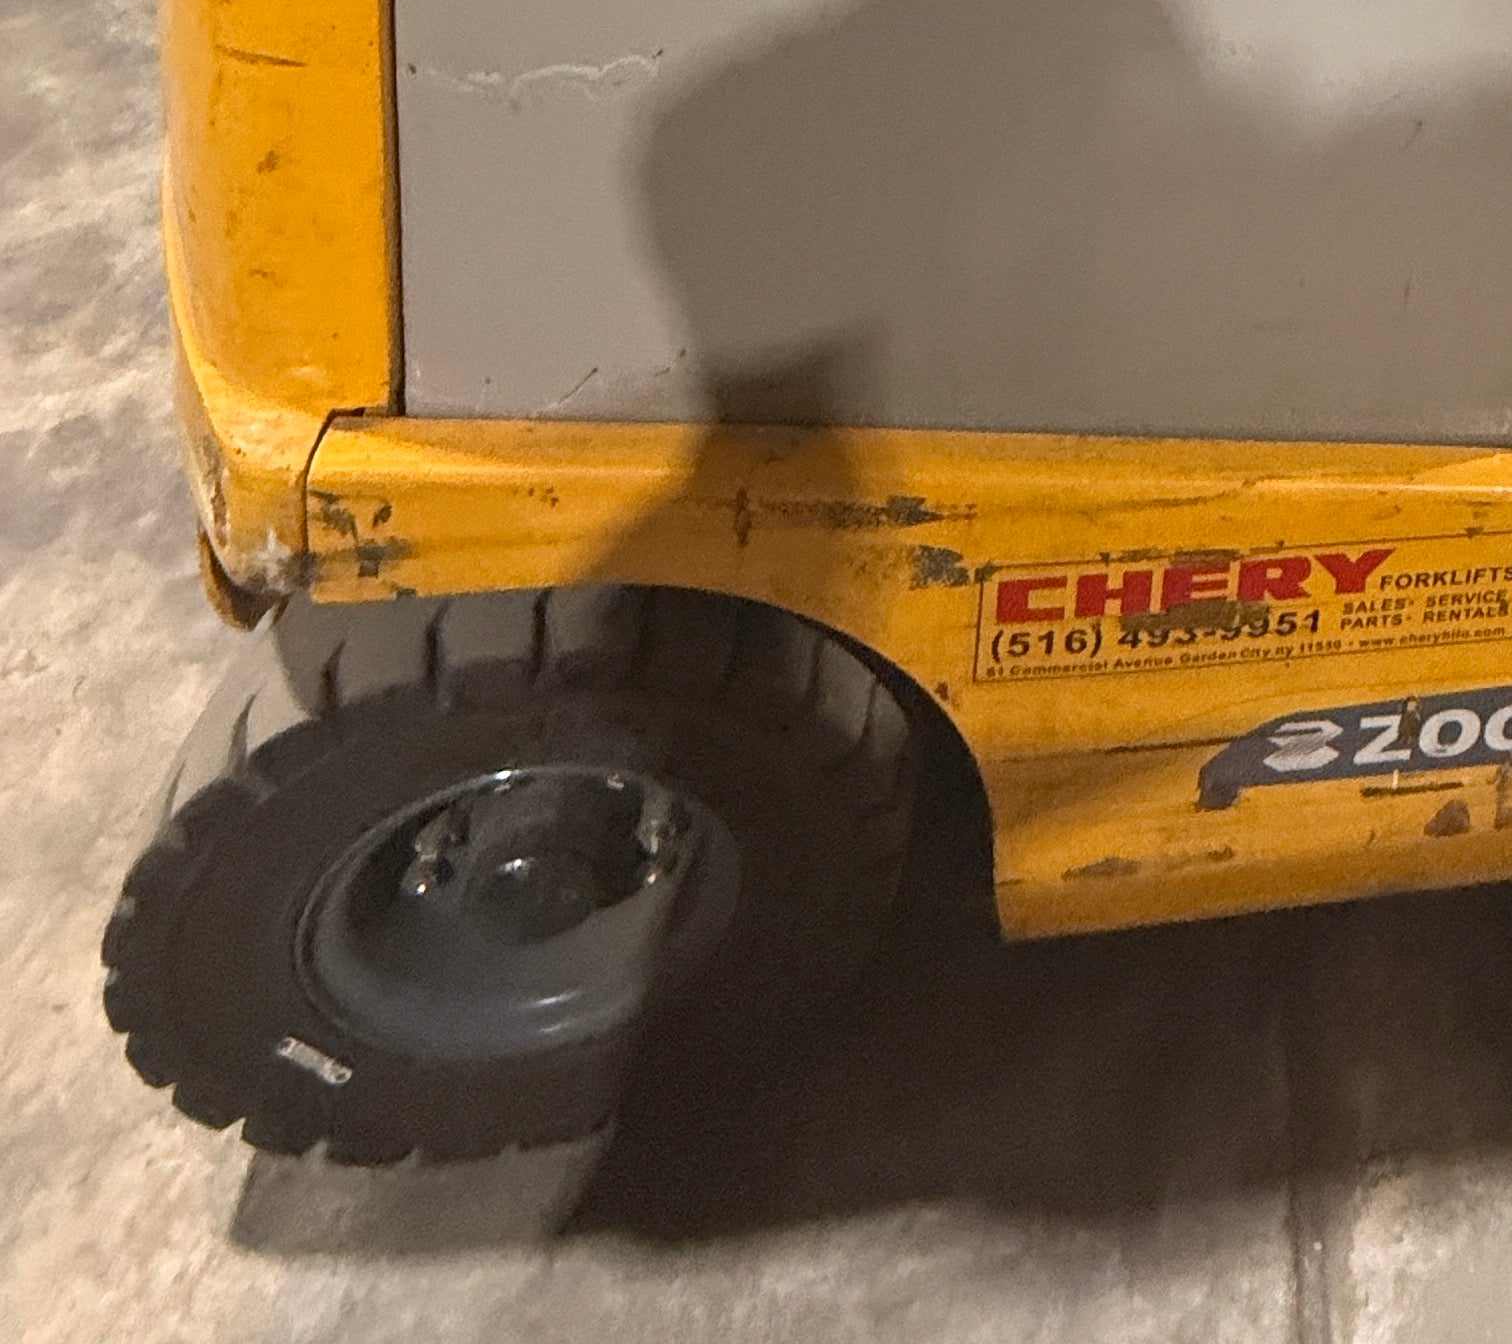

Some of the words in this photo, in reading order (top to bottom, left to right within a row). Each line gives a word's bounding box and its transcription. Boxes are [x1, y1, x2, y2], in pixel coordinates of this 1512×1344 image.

[996, 547, 1397, 625] CHERY
[1425, 589, 1508, 610] SERVICE
[1422, 603, 1510, 625] RENTALS
[991, 626, 1102, 662] (516)
[1114, 655, 1173, 671] Avenue
[1179, 650, 1236, 664] Garden
